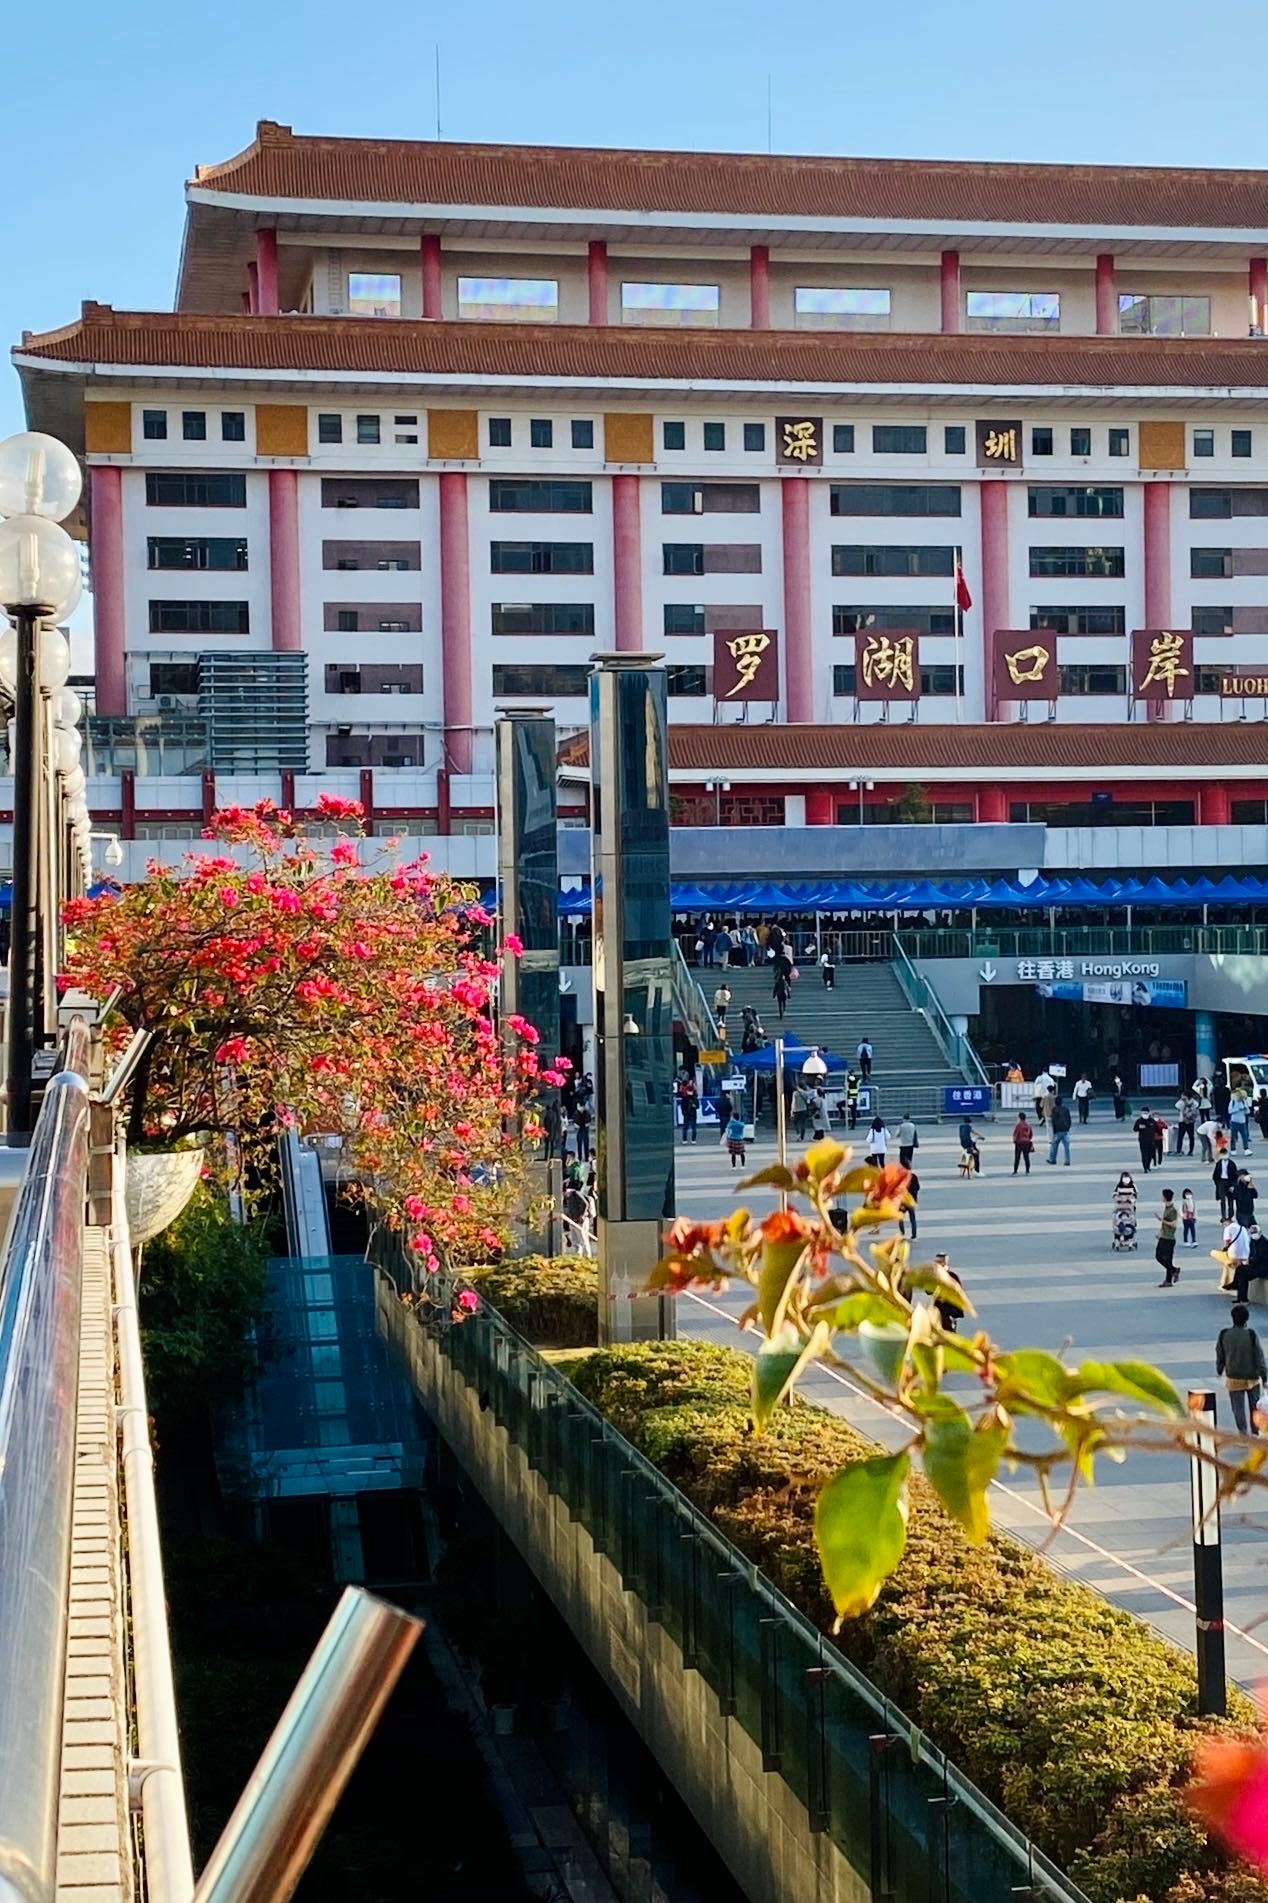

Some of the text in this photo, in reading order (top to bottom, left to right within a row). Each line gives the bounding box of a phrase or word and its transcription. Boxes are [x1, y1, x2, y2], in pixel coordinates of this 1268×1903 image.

[725, 631, 1190, 698] 罗湖口岸
[1017, 960, 1160, 980] 往香港 HongKong
